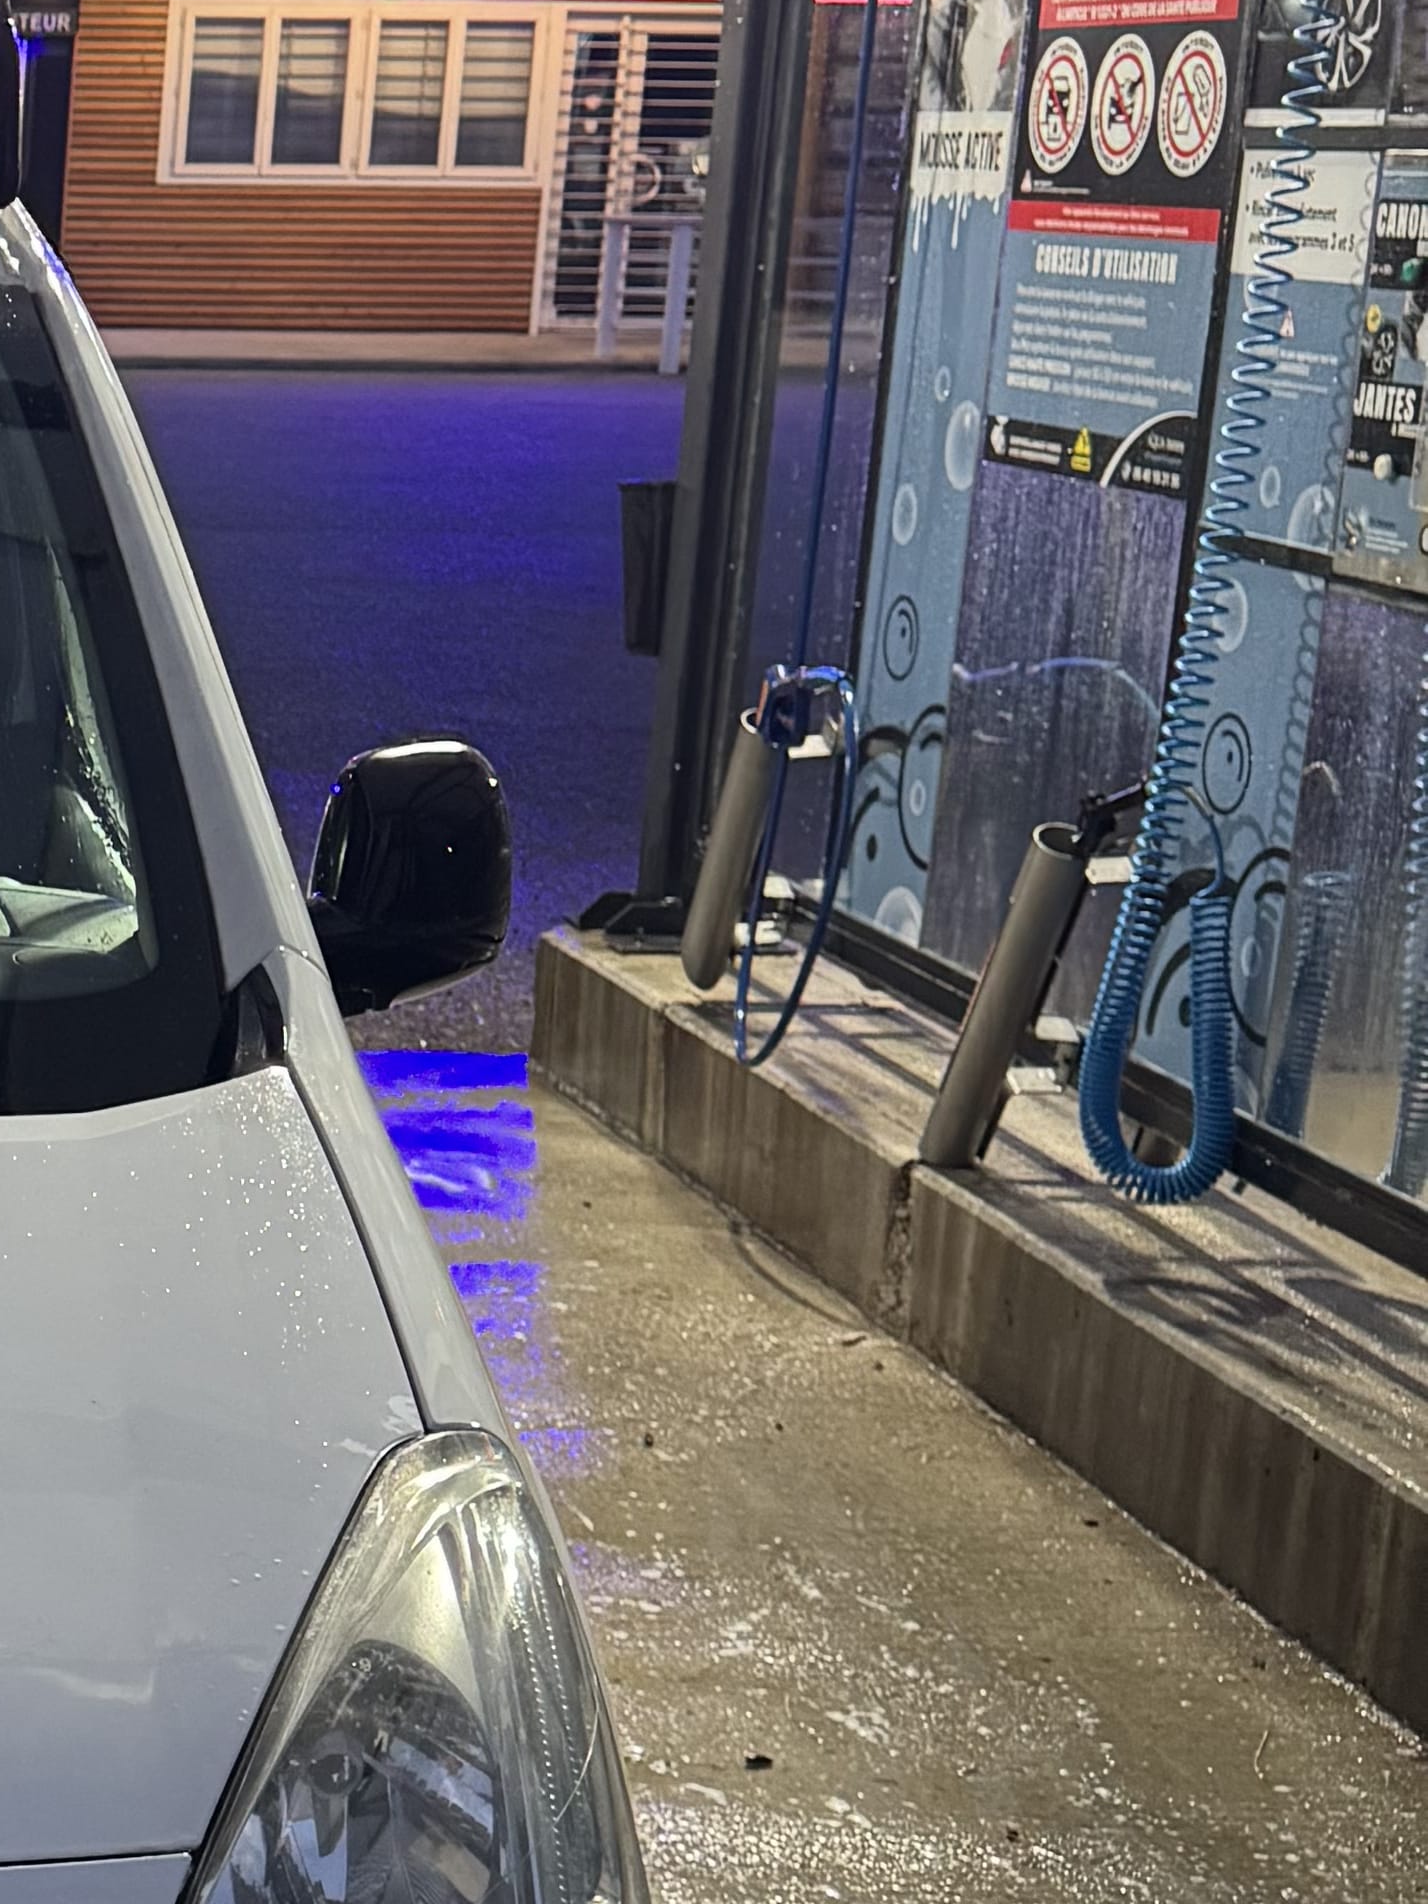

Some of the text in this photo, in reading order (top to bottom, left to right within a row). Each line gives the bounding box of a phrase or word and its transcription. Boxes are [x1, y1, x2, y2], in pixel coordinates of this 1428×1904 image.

[919, 130, 1003, 171] MOUSSE ACTIVE
[1376, 203, 1428, 239] CANON
[1035, 243, 1178, 285] CONSEILS D'UTILISATION
[1353, 382, 1417, 424] JANTES
